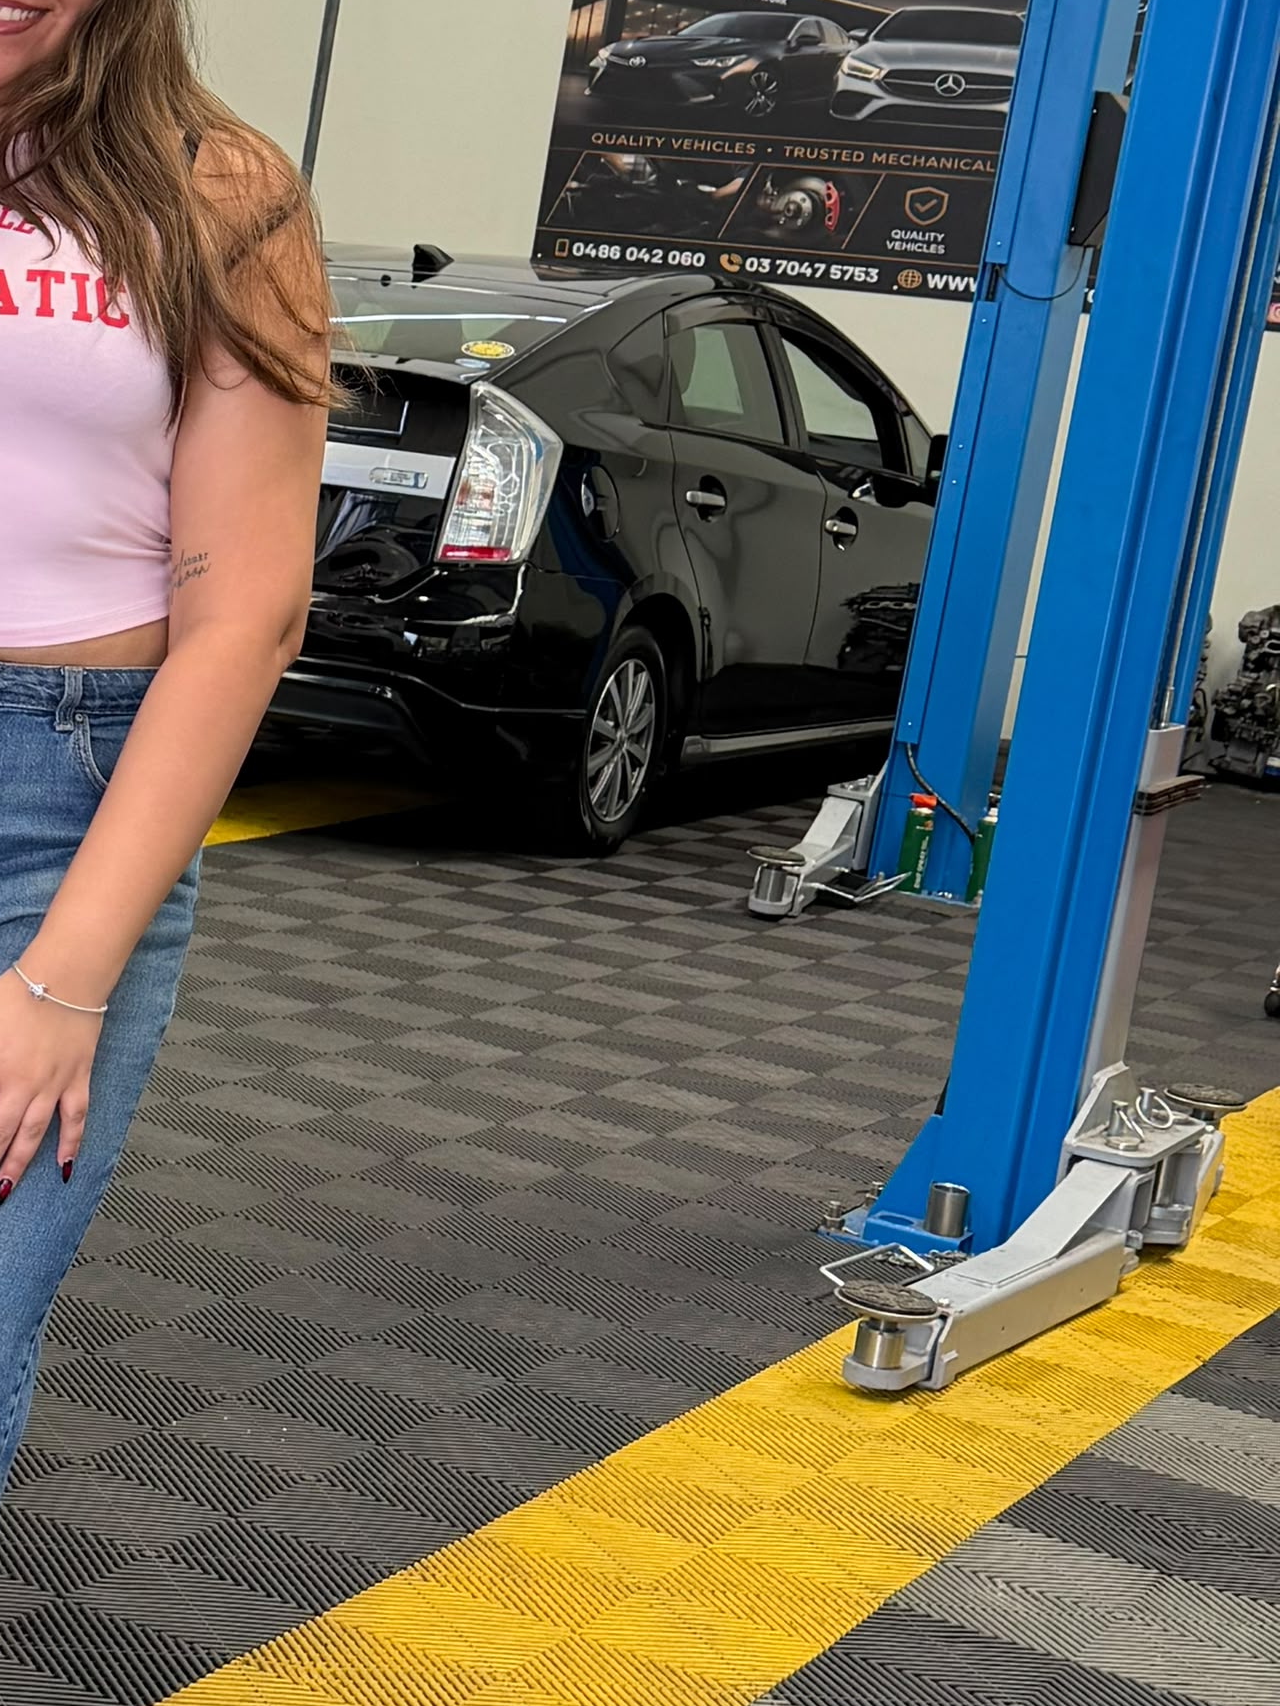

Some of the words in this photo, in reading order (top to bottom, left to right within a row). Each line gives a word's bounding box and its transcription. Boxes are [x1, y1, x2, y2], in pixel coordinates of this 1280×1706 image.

[591, 133, 666, 148] QUALITY
[671, 138, 756, 155] VEHICLES
[784, 146, 865, 163] TRUSTED
[872, 153, 995, 172] MECHANICAL
[885, 240, 946, 255] VEHICLES
[891, 229, 945, 243] QUALITY
[572, 242, 621, 260] 0486
[625, 246, 663, 264] 042
[668, 250, 706, 267] 060
[745, 257, 770, 273] 03
[775, 260, 826, 279] 7047
[829, 265, 880, 283] 5753
